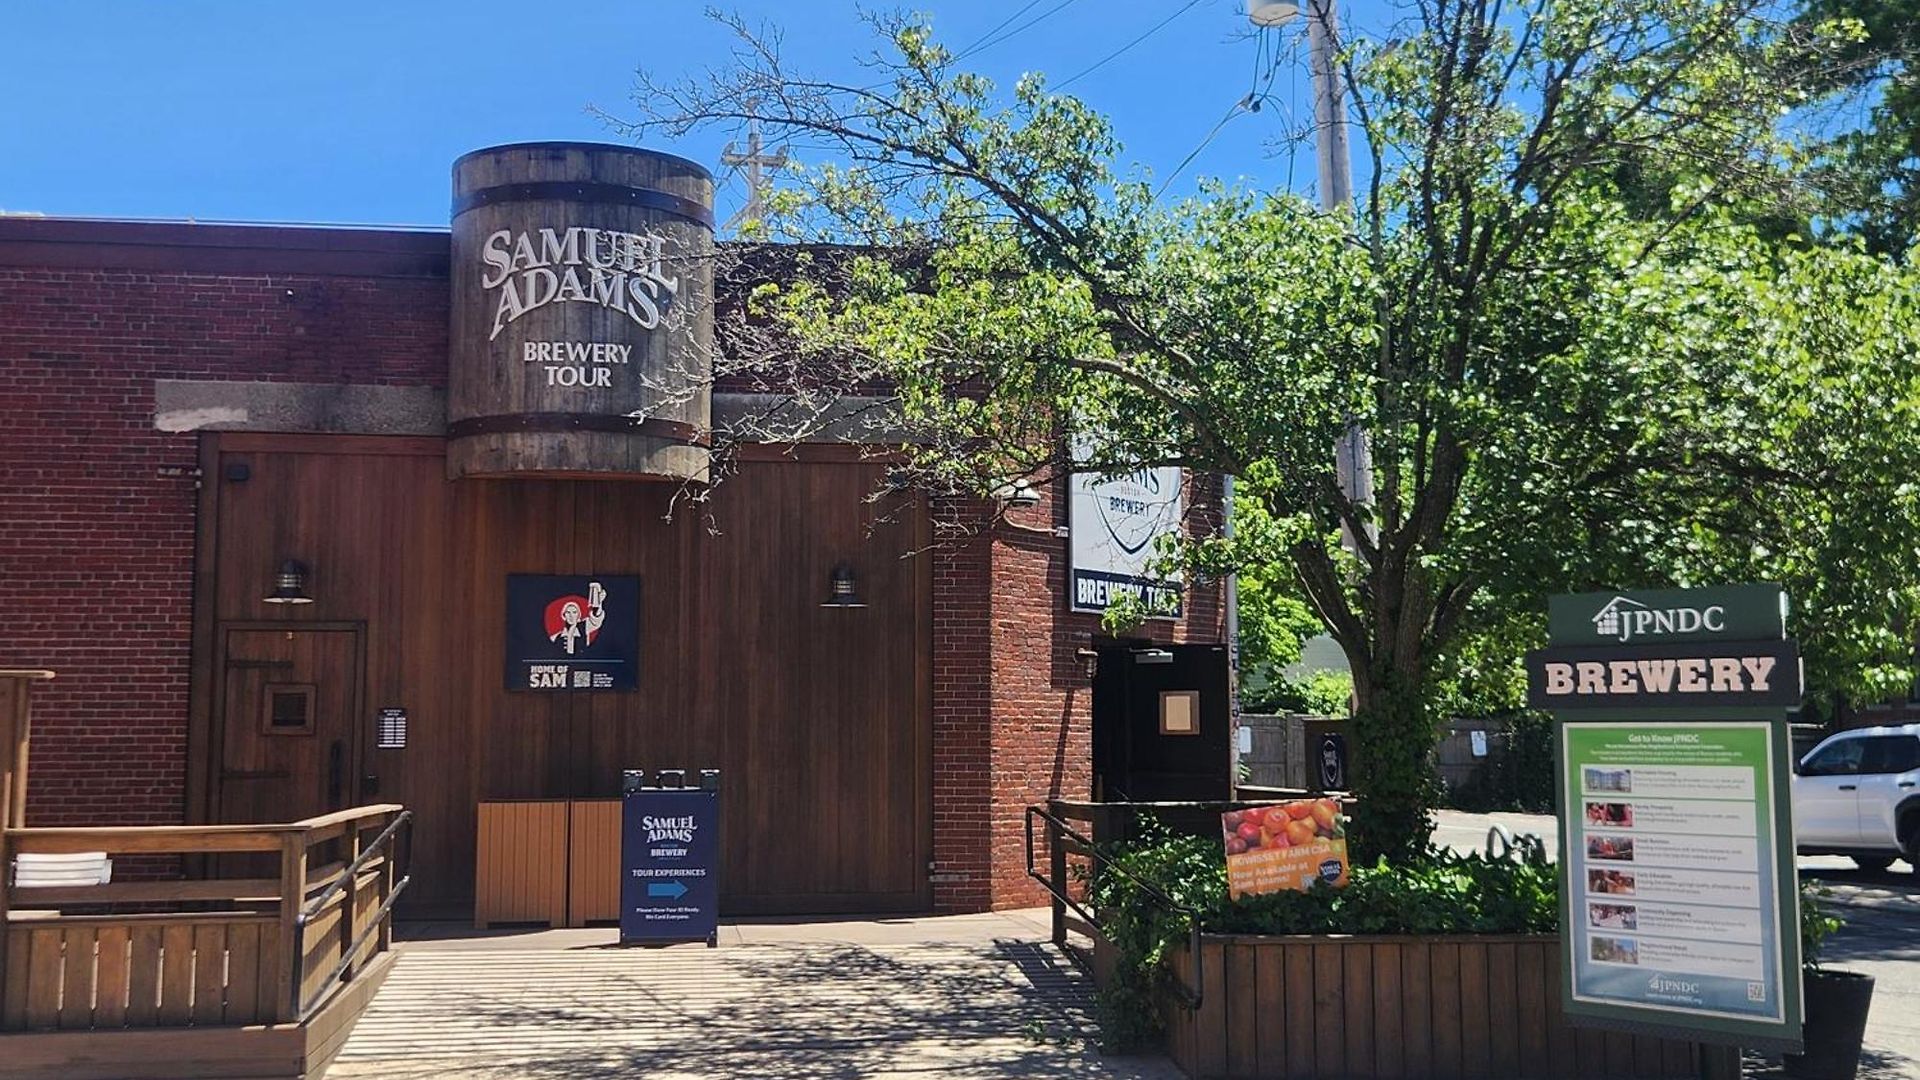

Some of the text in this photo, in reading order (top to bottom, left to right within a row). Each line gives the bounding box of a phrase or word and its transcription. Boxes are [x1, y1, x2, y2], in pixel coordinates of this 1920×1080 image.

[482, 227, 678, 293] SAMUEL
[489, 266, 659, 341] ADAMS
[524, 341, 632, 364] BREWERY
[544, 366, 612, 388] TOUR
[1619, 606, 1724, 642] JPNDC
[531, 665, 569, 674] HOME OF
[1545, 657, 1776, 695] BREWERY
[529, 673, 567, 688] SAM
[1628, 733, 1641, 743] Get
[1642, 734, 1651, 743] to
[1651, 734, 1673, 743] Know
[642, 815, 698, 831] SAMUEL
[647, 829, 693, 844] ADAMS
[651, 848, 688, 857] BREWERY
[632, 868, 706, 877] TOUR EXPERIENCES
[1659, 979, 1699, 994] JPNDC
